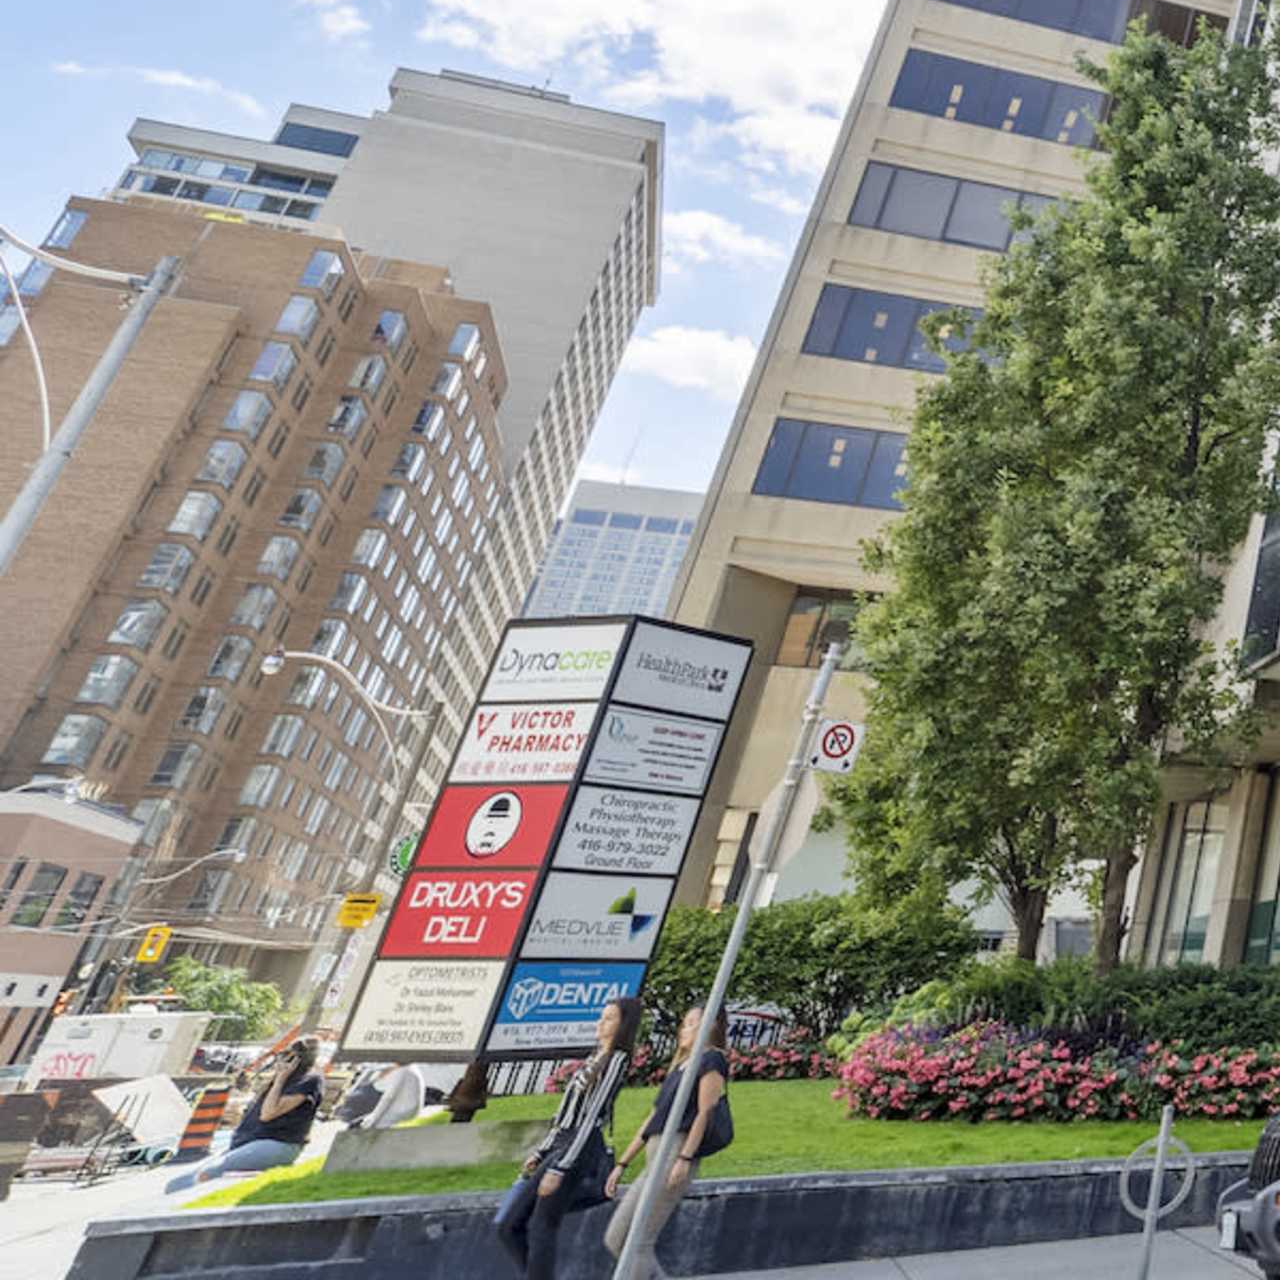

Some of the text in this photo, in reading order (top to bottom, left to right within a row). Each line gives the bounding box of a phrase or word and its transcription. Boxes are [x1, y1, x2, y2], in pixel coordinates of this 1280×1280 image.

[500, 648, 612, 678] Dynacare
[511, 710, 575, 729] VICTOR
[488, 733, 588, 752] PHARMACY
[423, 915, 487, 943] DELI
